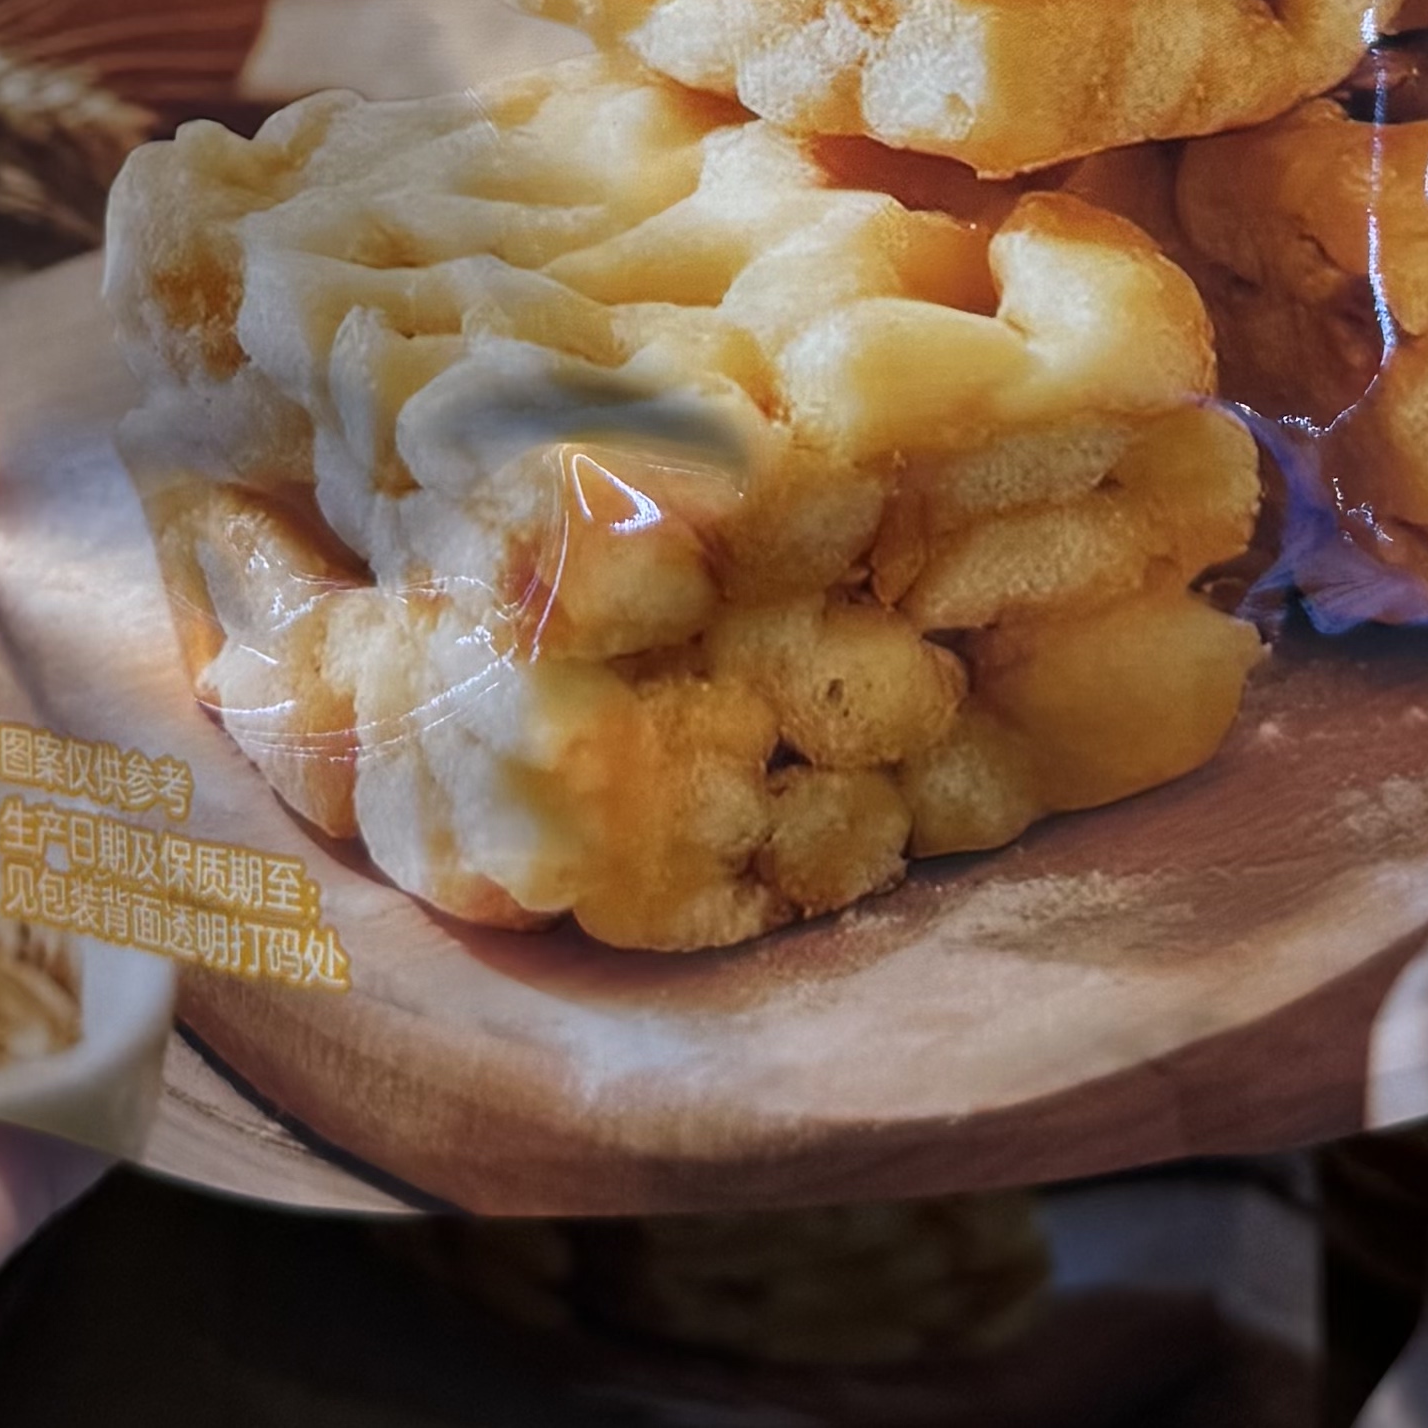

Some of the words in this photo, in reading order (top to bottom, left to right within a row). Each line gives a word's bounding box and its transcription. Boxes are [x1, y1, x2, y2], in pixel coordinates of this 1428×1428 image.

[0, 723, 192, 818] 图案仅供参考
